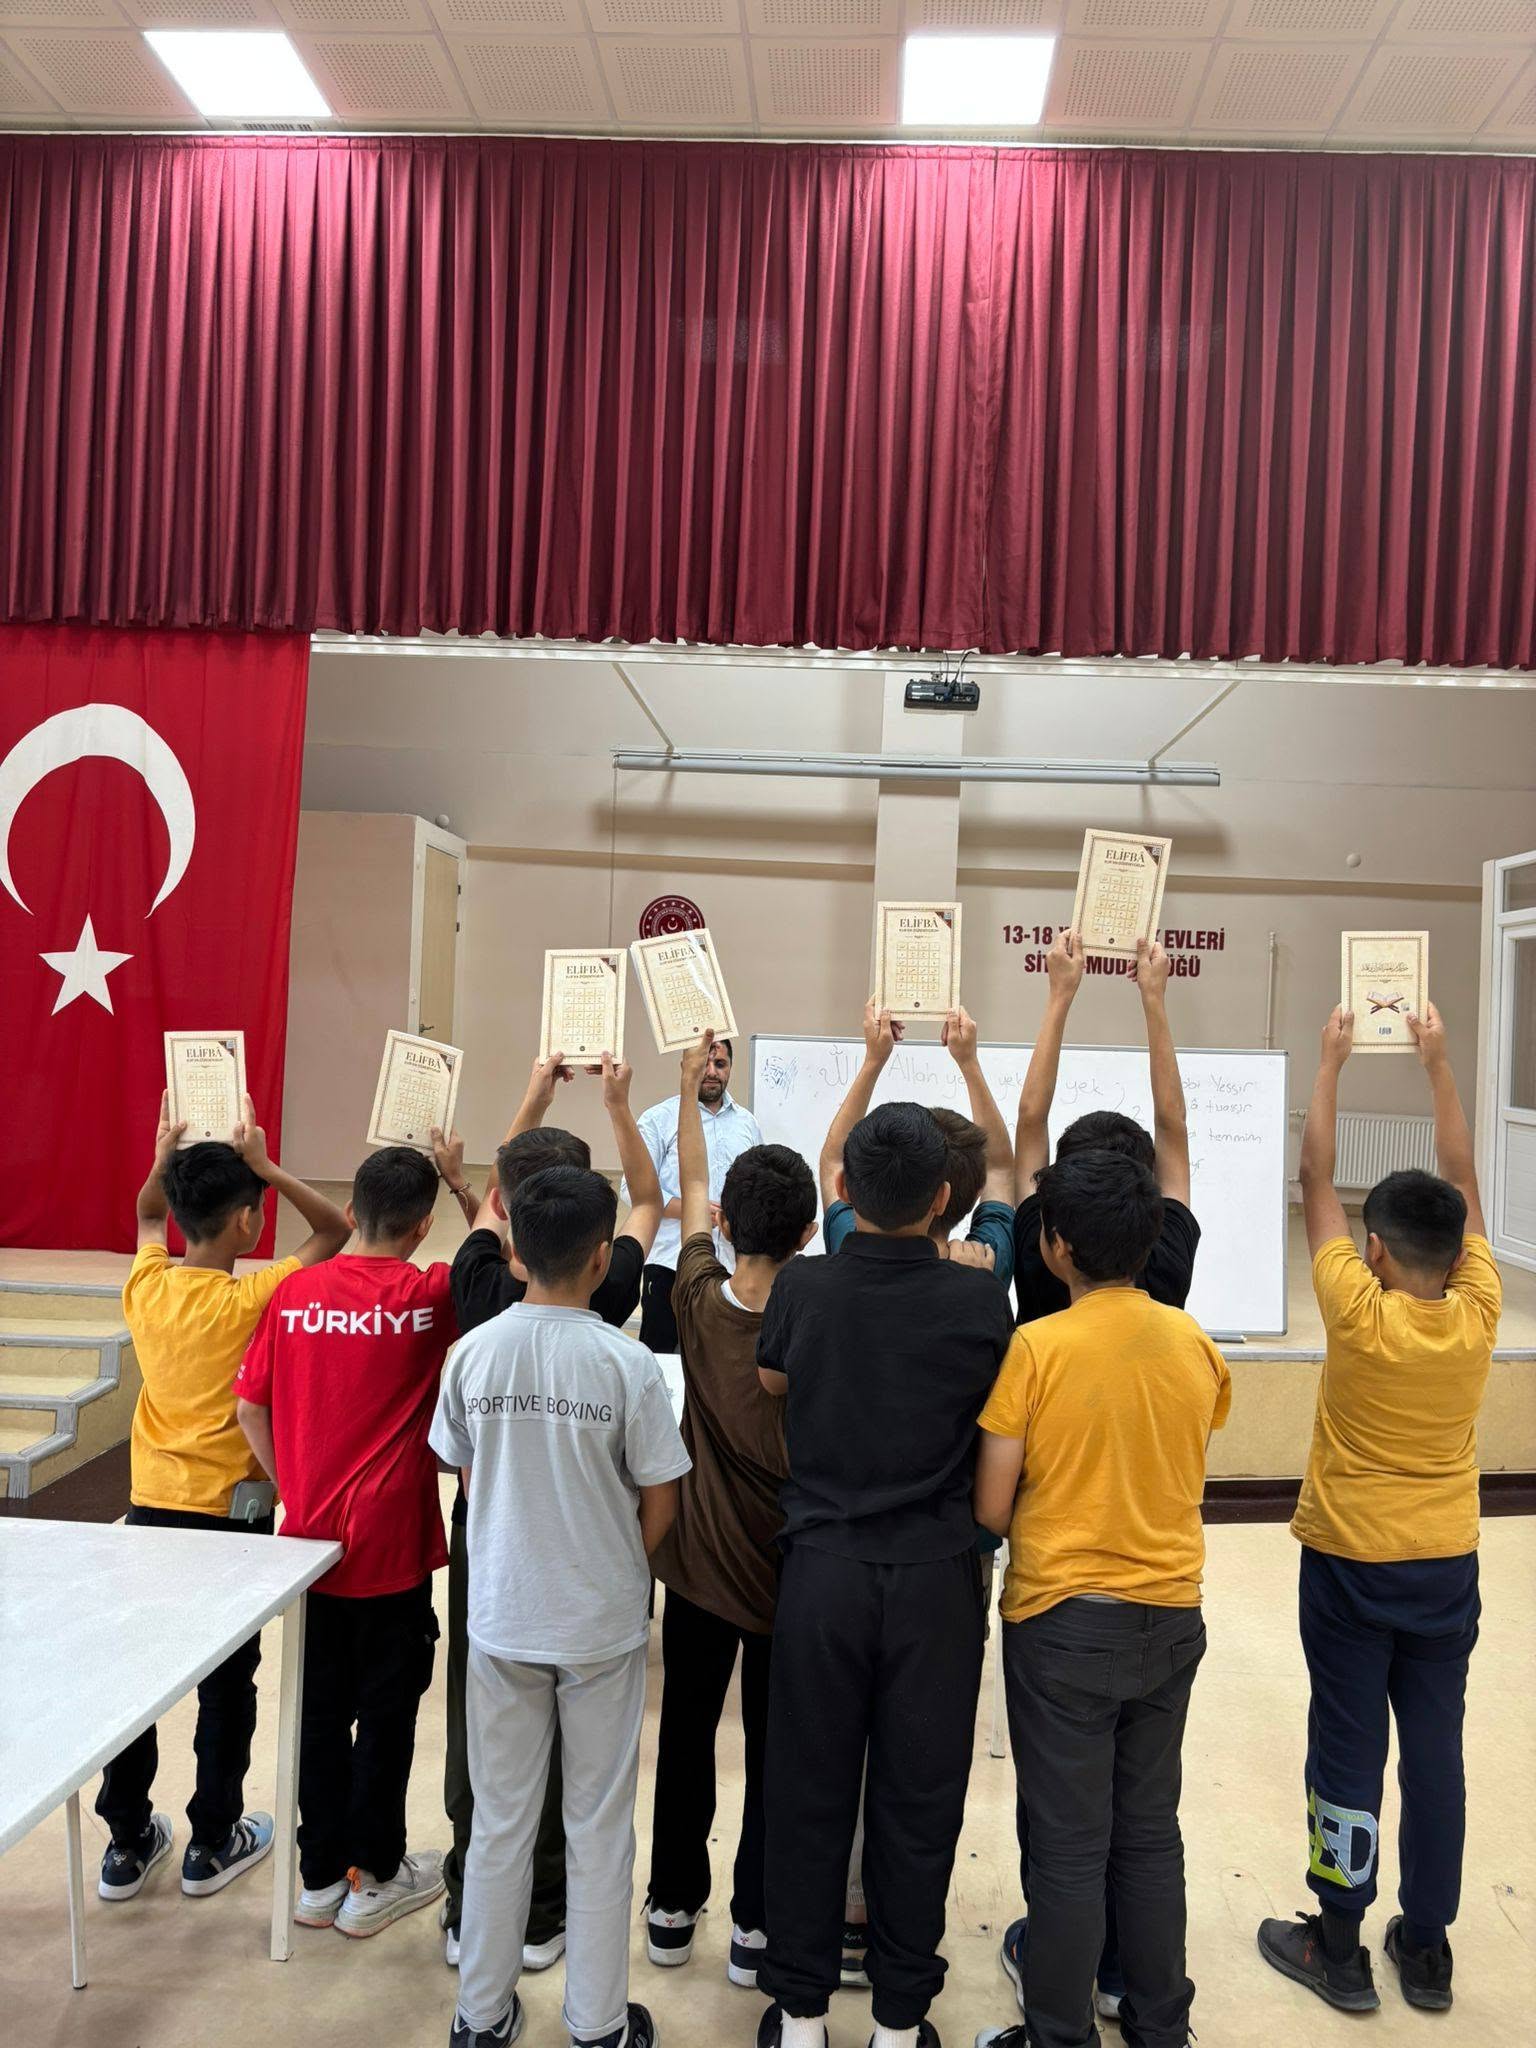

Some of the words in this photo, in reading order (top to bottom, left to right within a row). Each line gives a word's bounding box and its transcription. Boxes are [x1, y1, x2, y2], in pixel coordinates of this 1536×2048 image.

[1003, 925, 1053, 945] 13-18
[1164, 928, 1225, 951] EVLERİ
[280, 1301, 434, 1335] TÜRKİYE
[467, 1395, 541, 1415] SPORTIVE
[547, 1397, 613, 1422] BOXING
